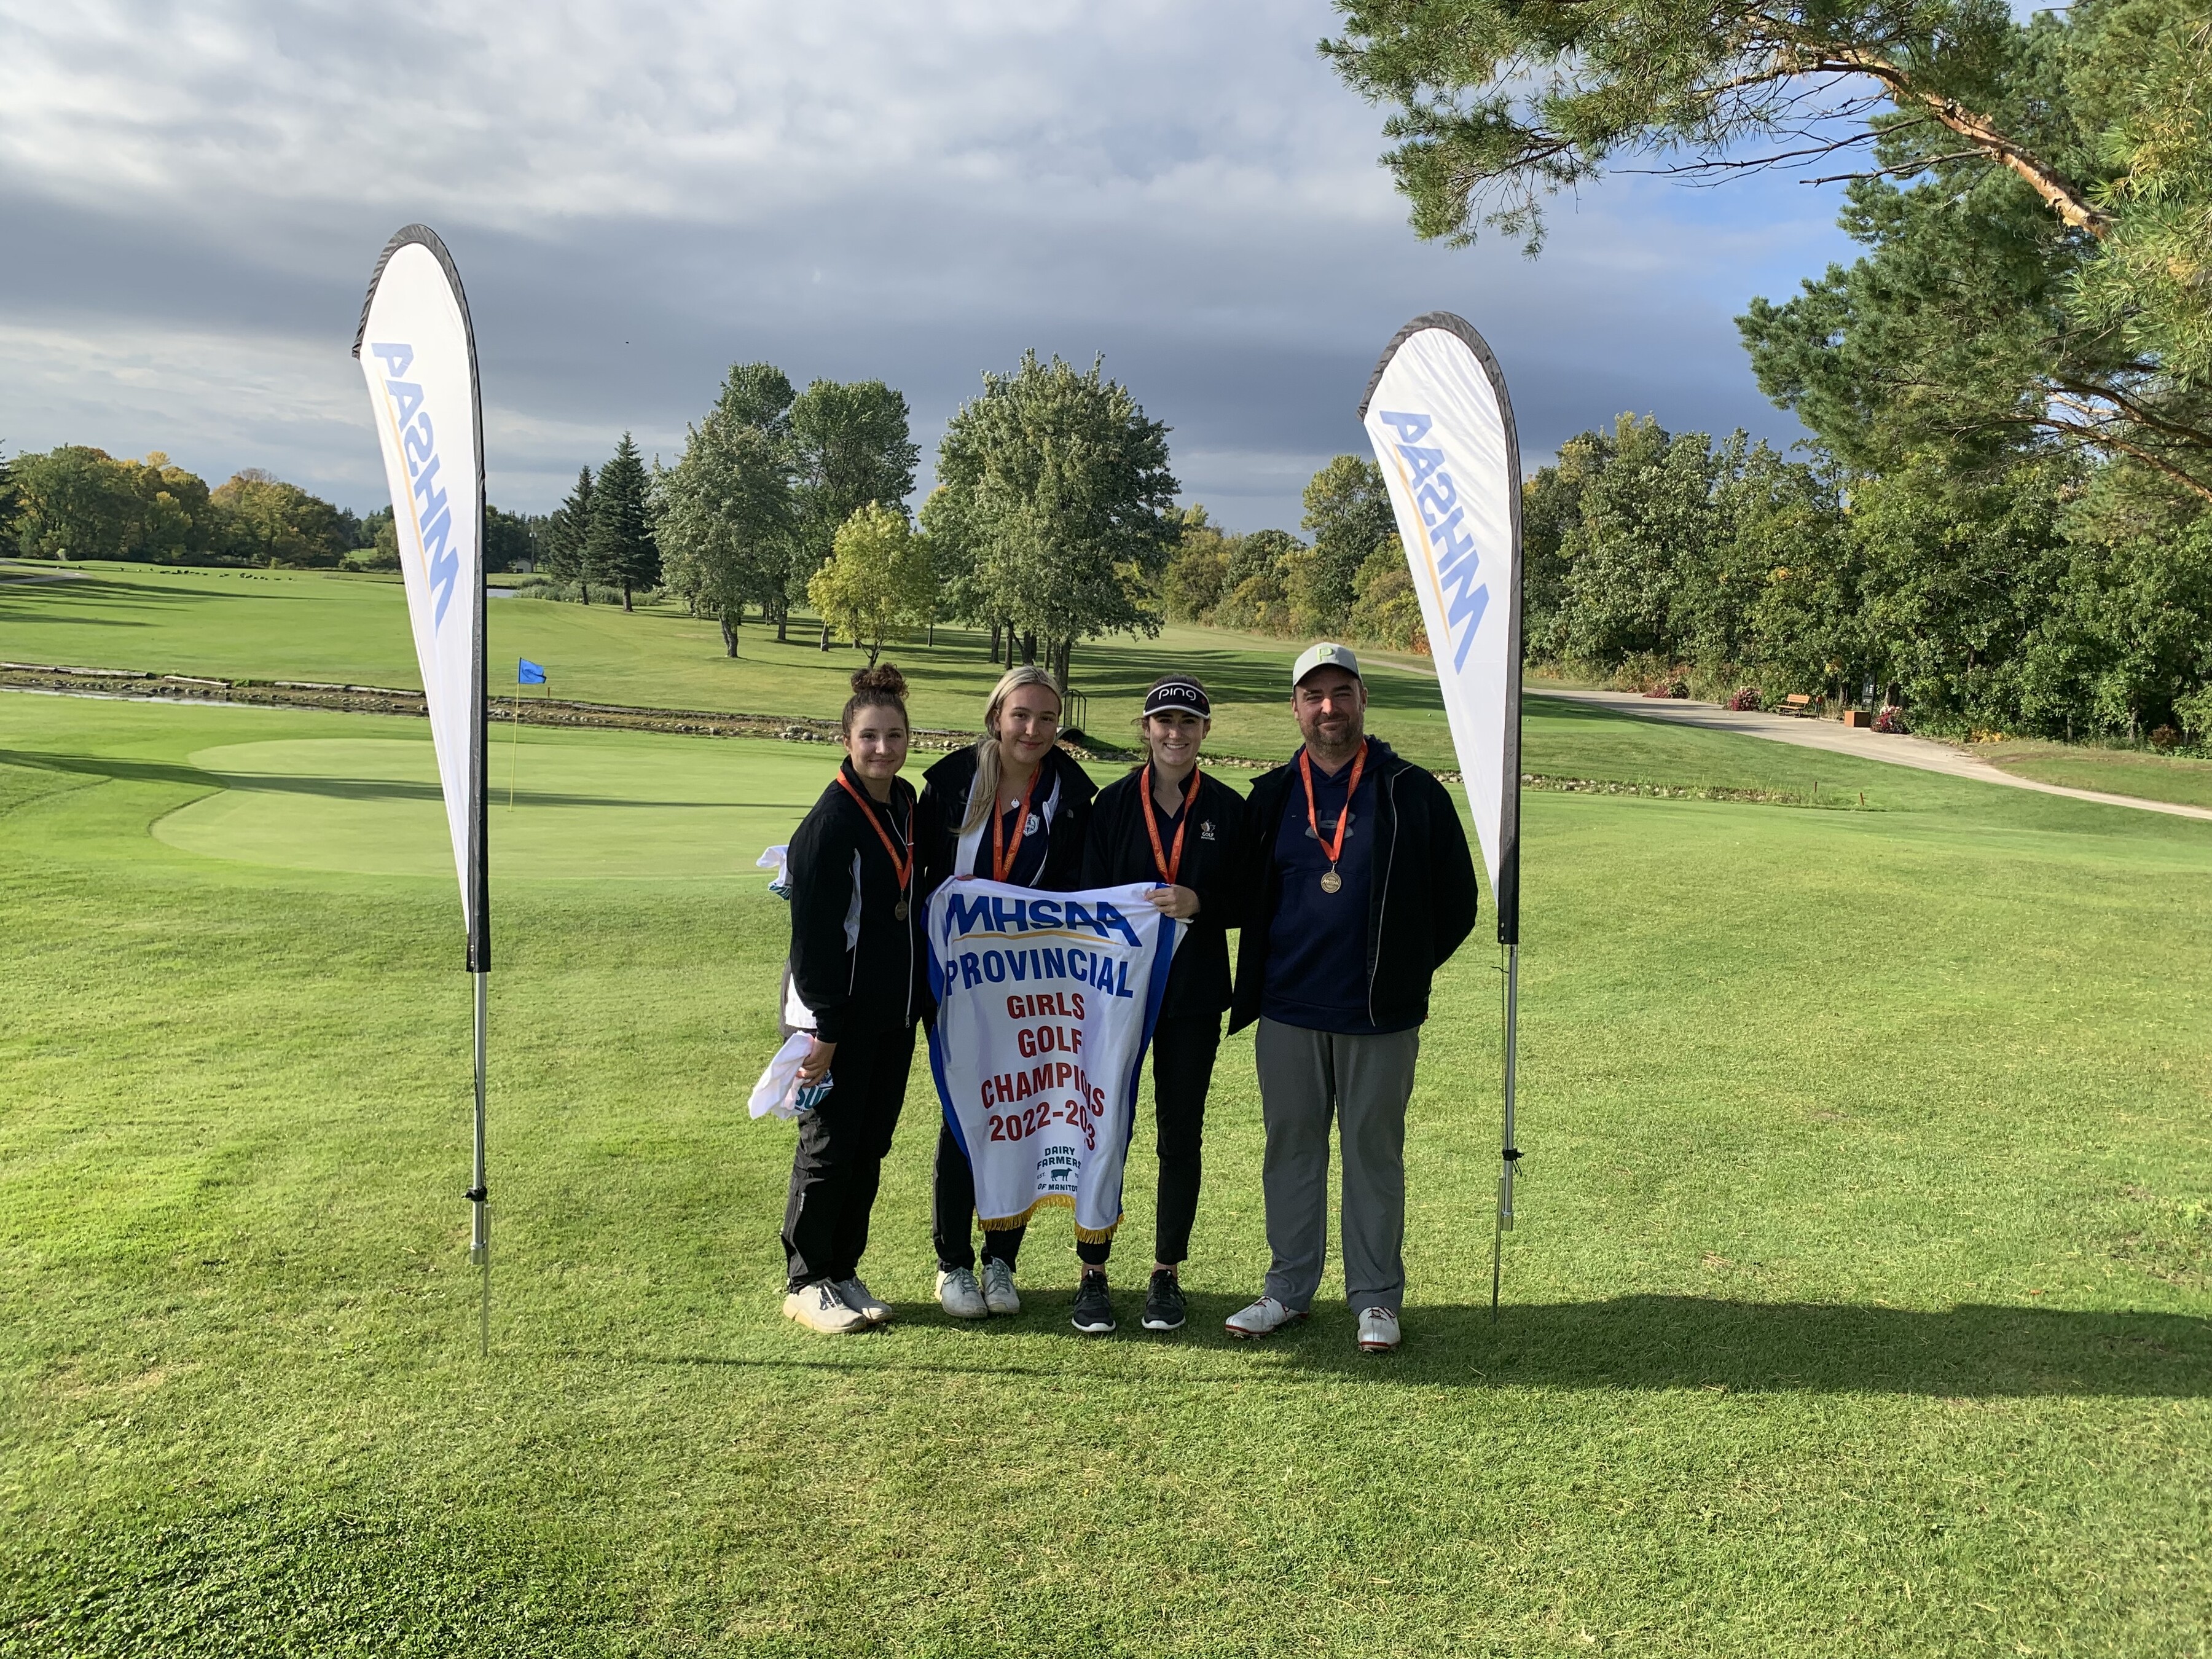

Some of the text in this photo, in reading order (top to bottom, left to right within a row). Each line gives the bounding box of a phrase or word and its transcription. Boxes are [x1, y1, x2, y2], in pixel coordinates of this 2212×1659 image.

[1158, 688, 1196, 701] ping
[946, 893, 1143, 947] MHSAA
[946, 948, 1134, 998] PROVINCIAL
[1006, 992, 1085, 1021] GIRLS
[1018, 1026, 1082, 1058] GOLF
[989, 1100, 1096, 1151] 2022-203
[1045, 1146, 1075, 1156] DAIRY
